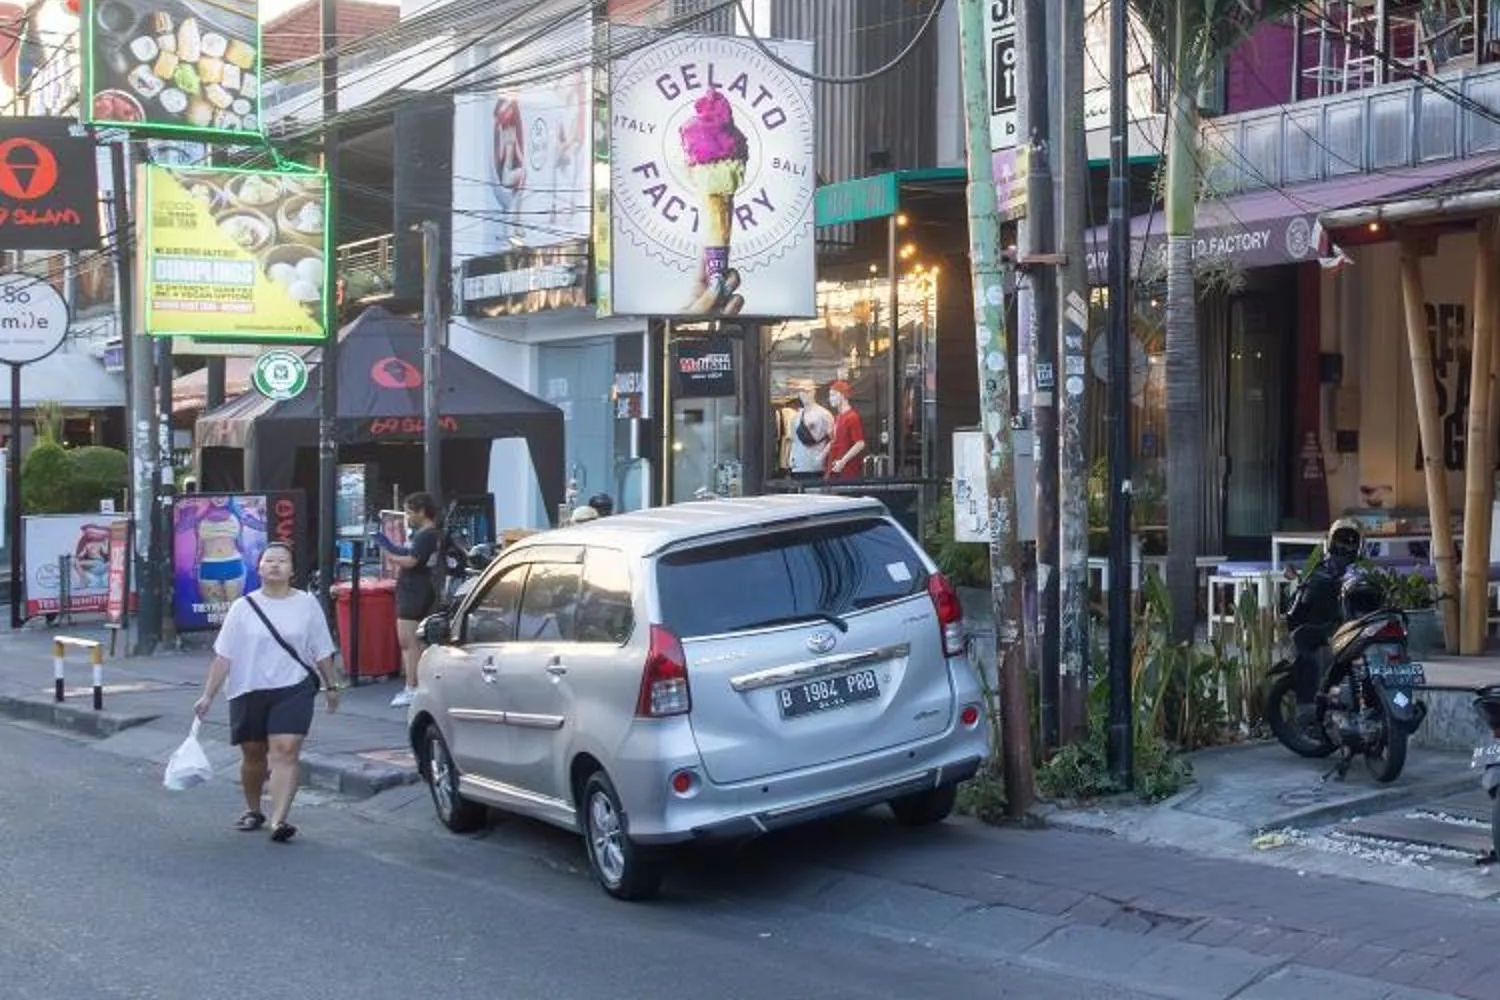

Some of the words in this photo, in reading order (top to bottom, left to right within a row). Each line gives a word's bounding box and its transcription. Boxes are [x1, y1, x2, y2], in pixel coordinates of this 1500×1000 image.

[655, 63, 788, 130] GELATO
[613, 114, 657, 135] ITALY
[771, 157, 806, 177] BALI
[1209, 229, 1271, 254] FACTORY
[781, 689, 793, 709] B
[803, 679, 838, 703] 1984
